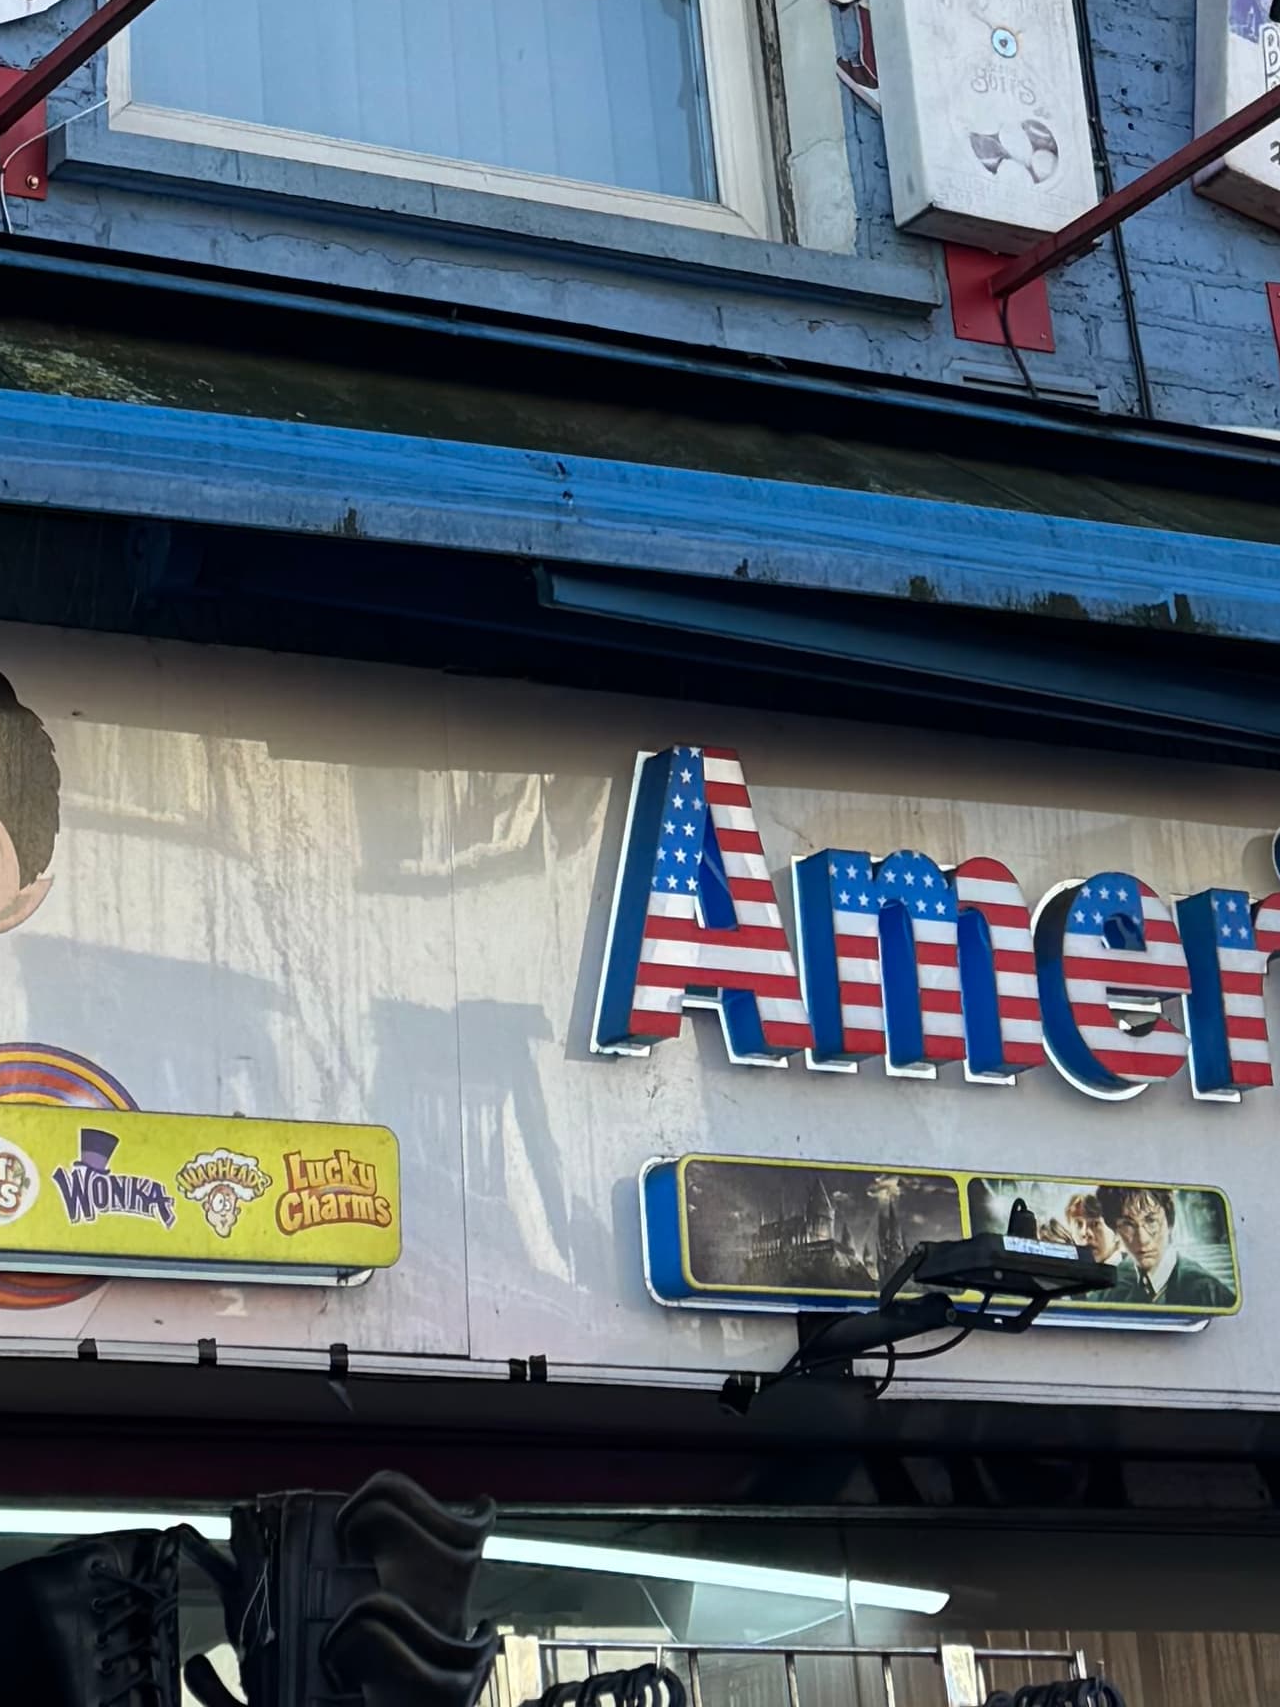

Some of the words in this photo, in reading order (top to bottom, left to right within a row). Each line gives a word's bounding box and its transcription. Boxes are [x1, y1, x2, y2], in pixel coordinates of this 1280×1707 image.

[177, 1158, 272, 1194] WARHEADS
[288, 1151, 378, 1196] Lucky
[53, 1167, 175, 1229] WONKA
[277, 1190, 393, 1234] Charms
